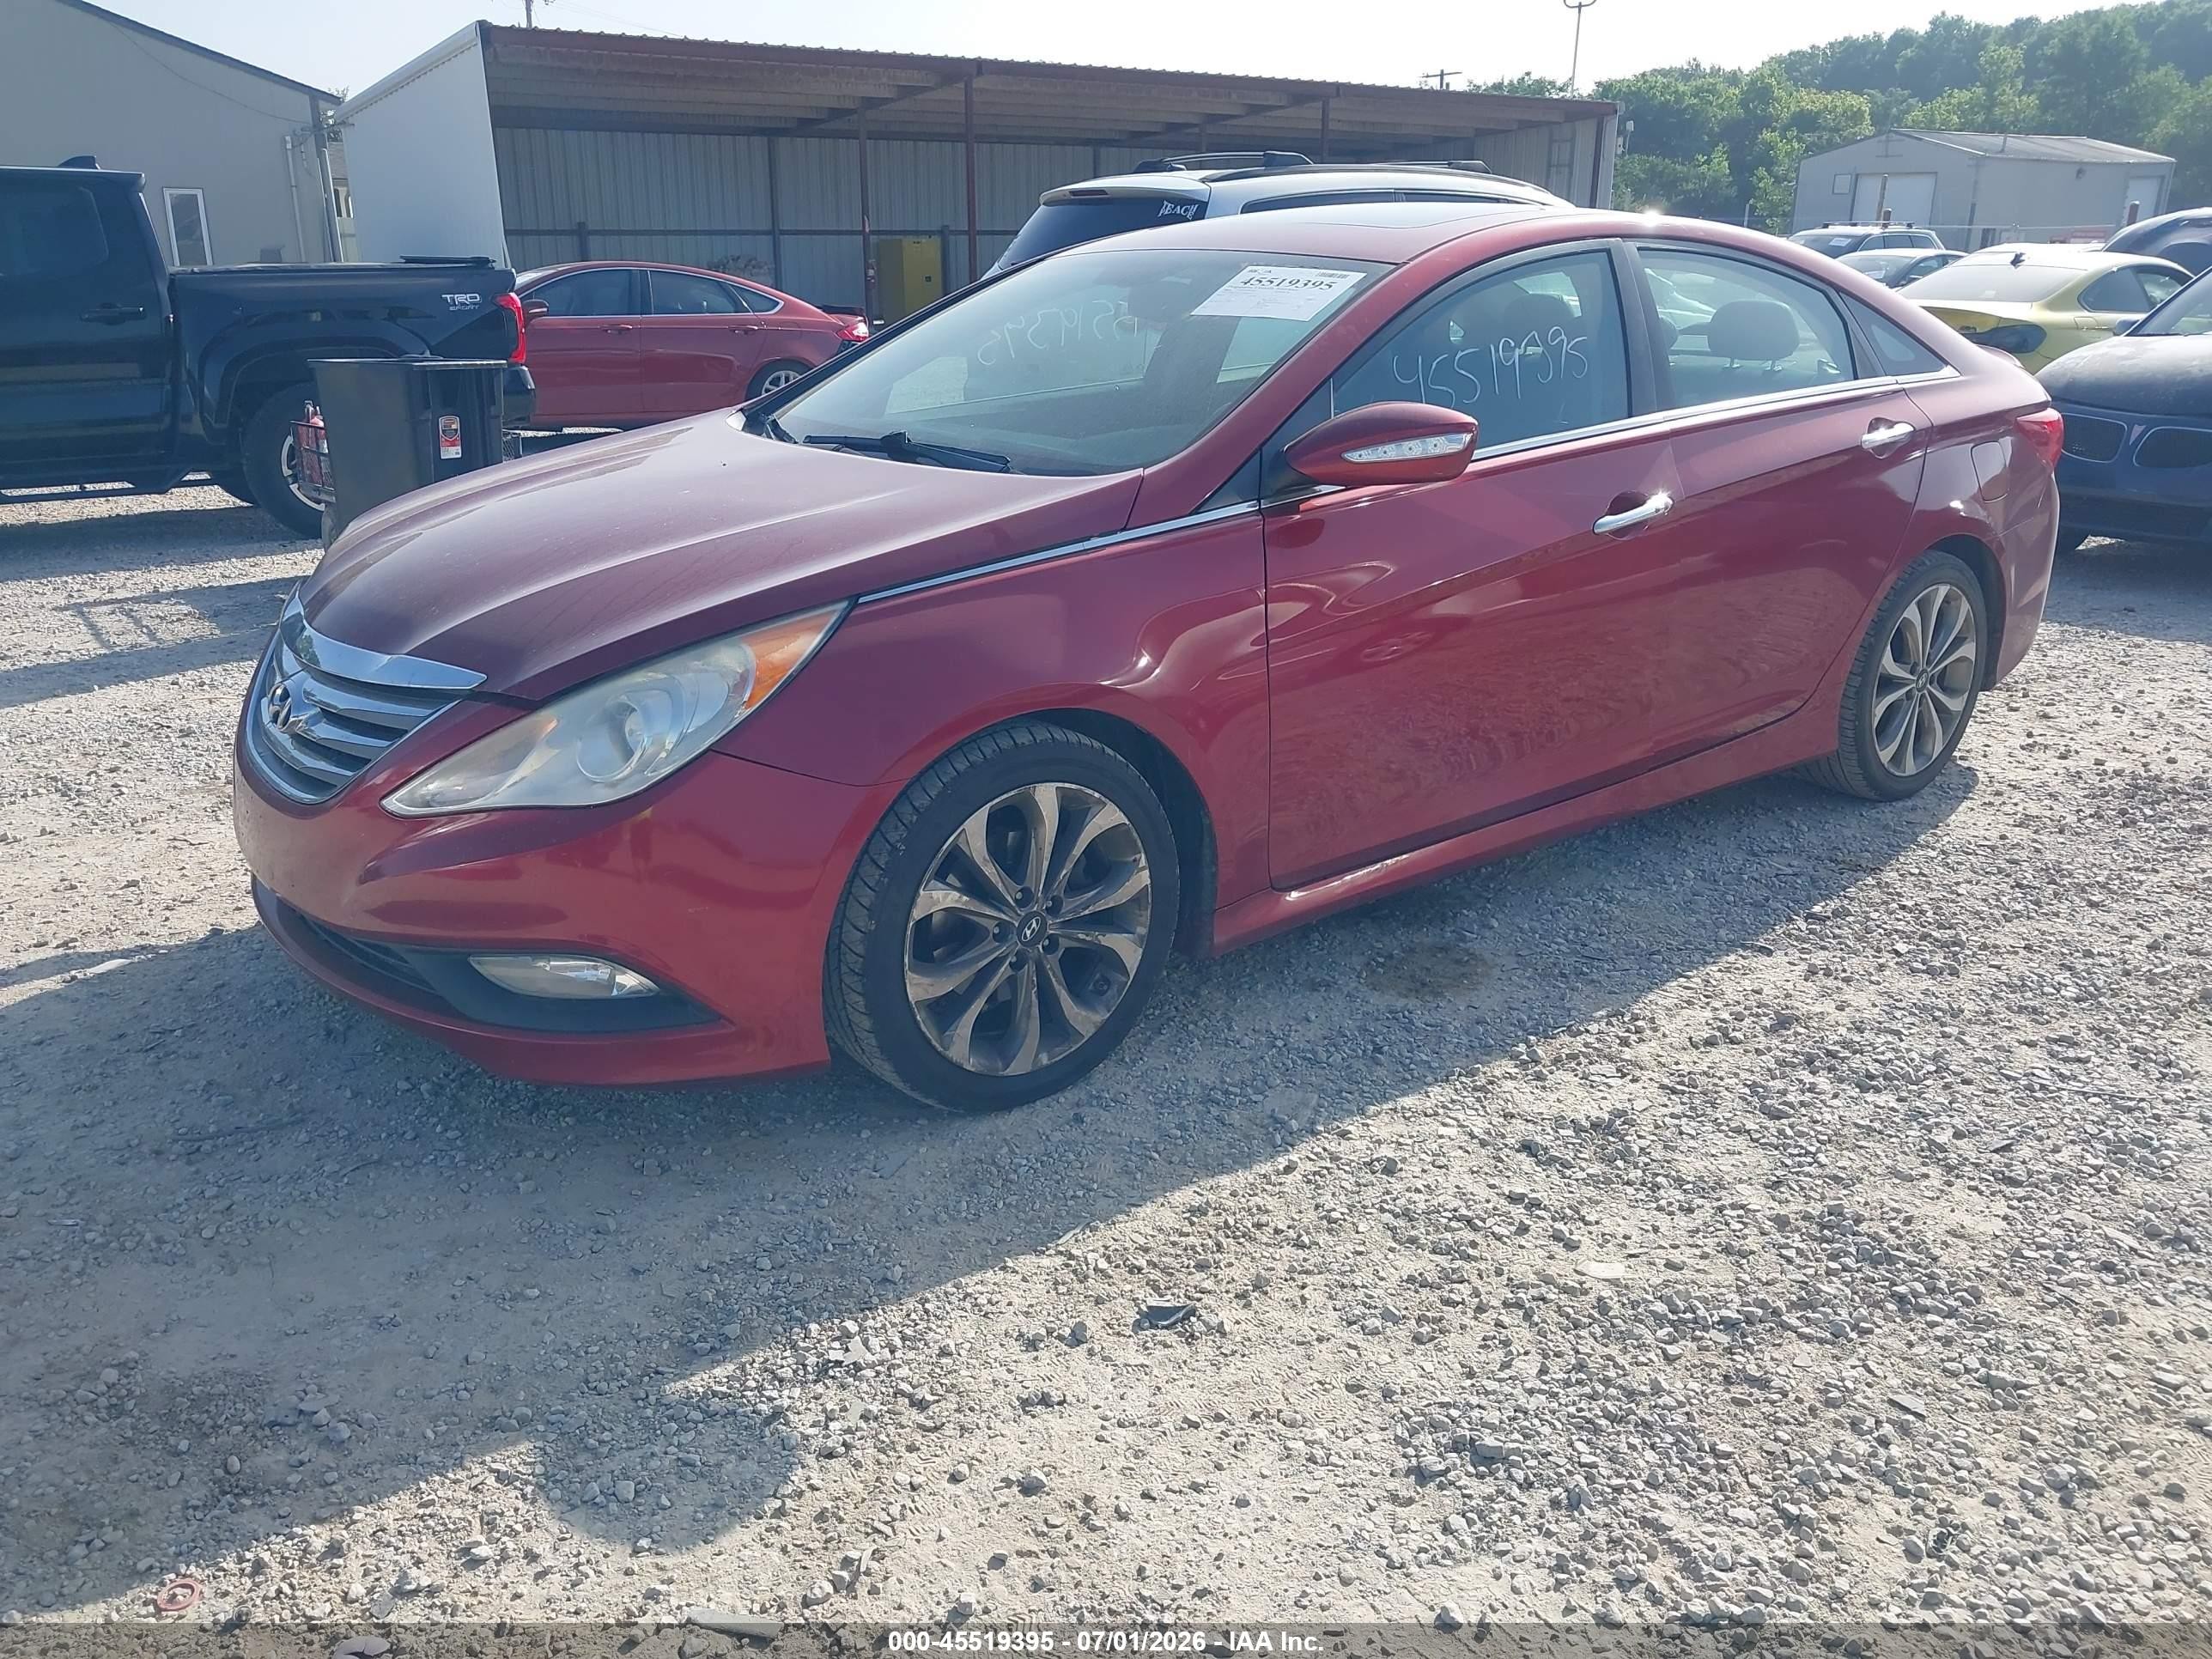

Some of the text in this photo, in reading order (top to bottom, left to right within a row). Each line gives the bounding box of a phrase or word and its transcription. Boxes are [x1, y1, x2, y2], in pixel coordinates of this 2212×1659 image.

[1239, 276, 1338, 291] 45519395
[441, 293, 481, 305] TRD
[1393, 325, 1589, 409] 45519395
